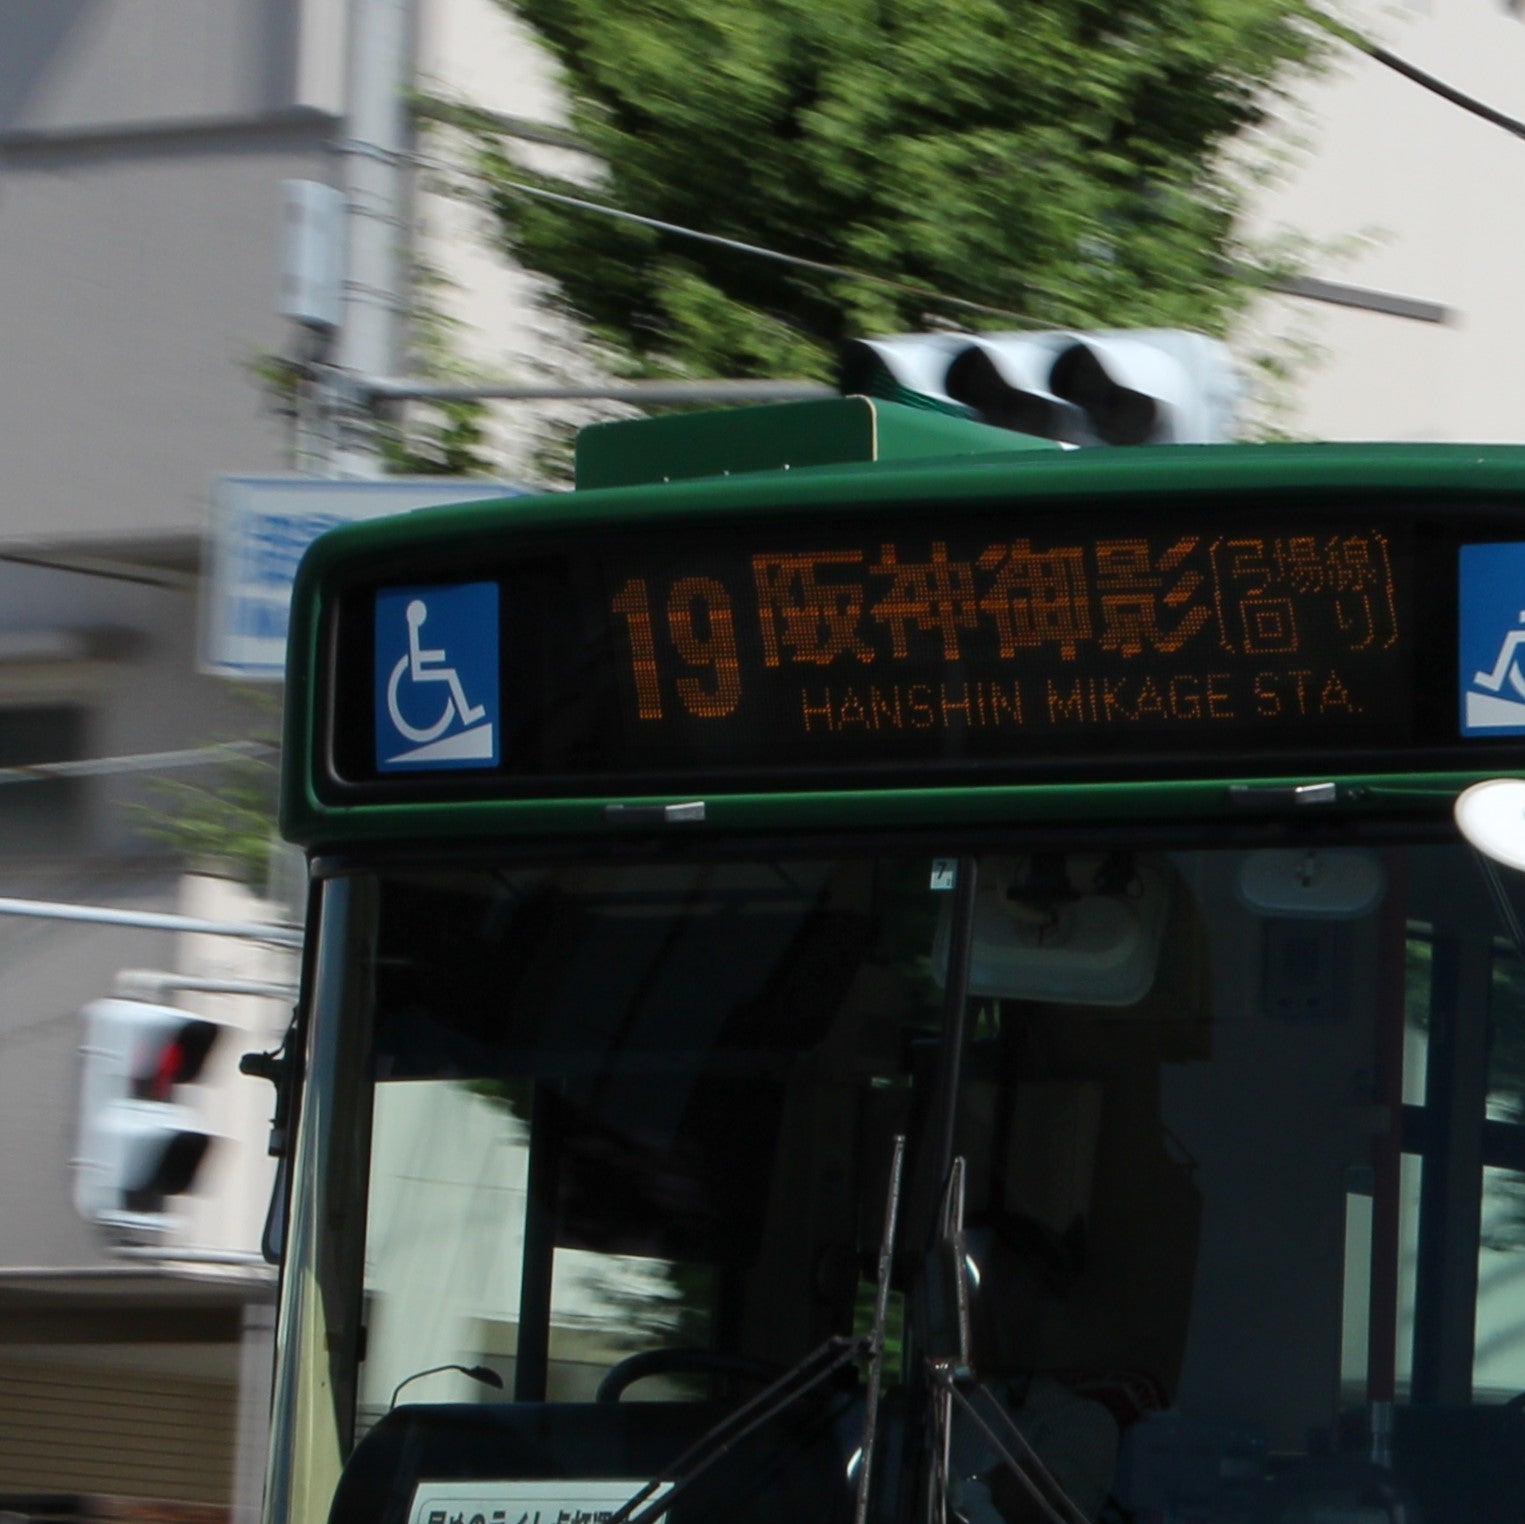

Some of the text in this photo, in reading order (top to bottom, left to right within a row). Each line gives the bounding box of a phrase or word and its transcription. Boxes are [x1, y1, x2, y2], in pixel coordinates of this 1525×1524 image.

[612, 576, 741, 719] 19
[751, 536, 1212, 668] 阪神御影
[802, 669, 1366, 732] HANSHIN MIKAGE STA.
